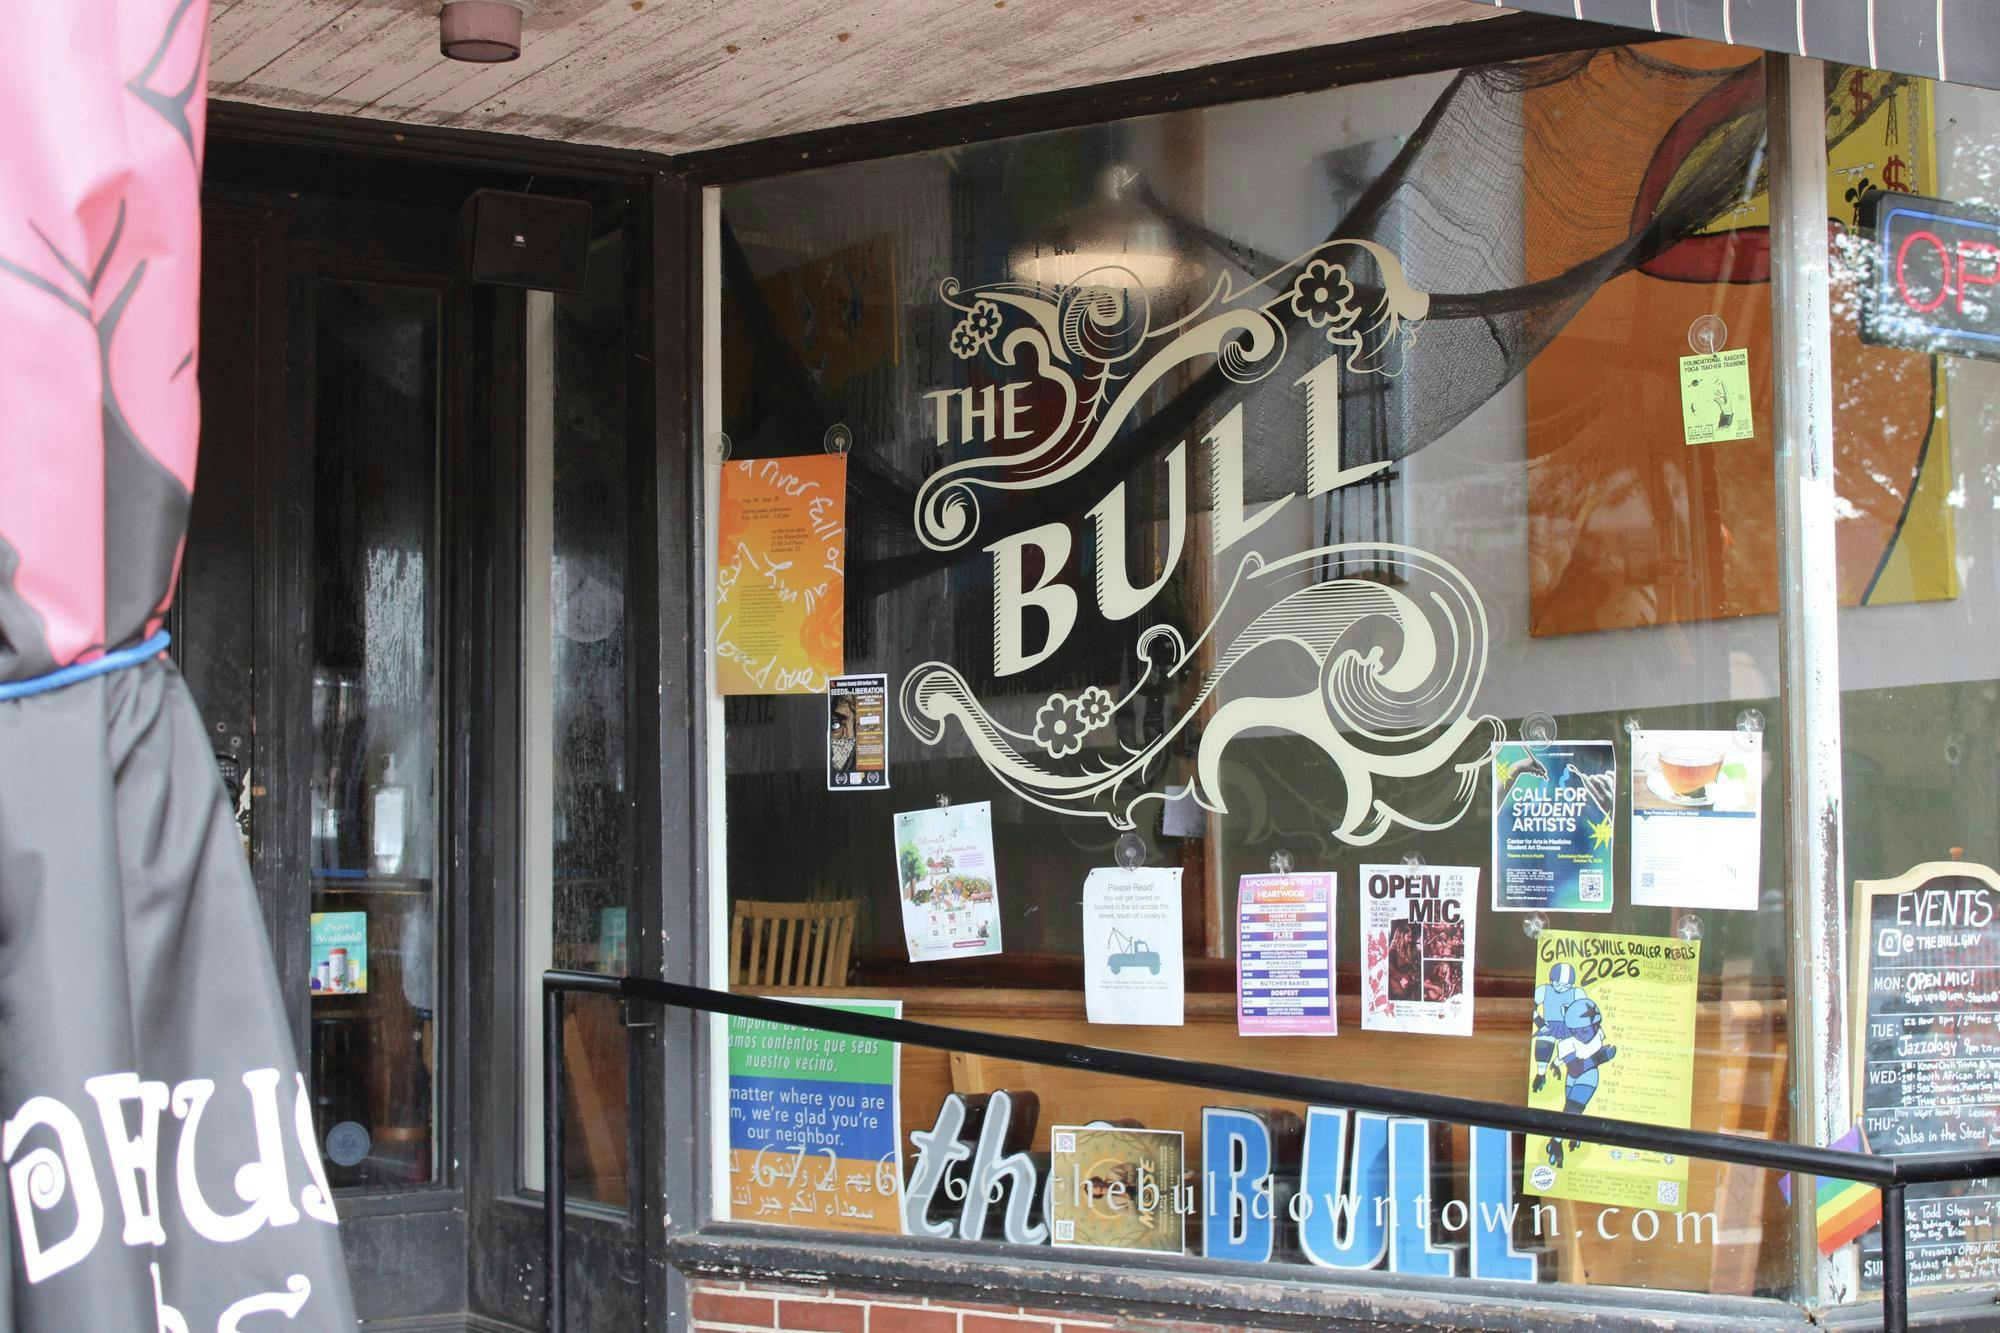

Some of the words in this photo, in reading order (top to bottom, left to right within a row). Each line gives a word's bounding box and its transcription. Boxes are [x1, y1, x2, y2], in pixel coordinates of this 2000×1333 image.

[922, 381, 1035, 446] THE
[761, 460, 820, 496] river
[809, 496, 843, 541] full
[982, 354, 1398, 677] BULL
[831, 688, 848, 696] SEEDS
[1511, 787, 1552, 802] CALL
[1554, 787, 1587, 802] FOR
[1511, 802, 1586, 817] STUDENT
[1511, 817, 1577, 832] ARTISTS
[1107, 883, 1132, 892] Please
[1246, 878, 1289, 887] UPCOMING
[1290, 877, 1322, 886] EVENTS
[1368, 874, 1441, 899] OPEN
[1257, 889, 1306, 898] HEARTWOOD
[1409, 899, 1461, 924] MIC
[1897, 889, 1992, 927] EVENTS
[1541, 938, 1626, 963] GAINESVILLE
[1628, 942, 1661, 959] ROLLER
[1664, 947, 1696, 960] REBELS
[1580, 957, 1640, 987] 2026
[1642, 960, 1668, 971] ROLLER
[1669, 963, 1692, 973] DERBY
[1643, 972, 1664, 981] HOME
[1665, 974, 1693, 983] SEASON
[1873, 977, 1905, 991] MON:
[1907, 972, 1941, 991] OPEN
[1944, 972, 1975, 987] MIC!
[1871, 1024, 1900, 1038] TUE:
[762, 1034, 820, 1052] contentos
[823, 1039, 846, 1056] que
[851, 1041, 879, 1055] seas
[1898, 1032, 1957, 1057] Jazzology
[746, 1054, 791, 1070] nuestro
[795, 1053, 839, 1073] vecino.
[1917, 1070, 1940, 1082] South
[1943, 1070, 1973, 1081] African
[1975, 1070, 1990, 1080] Trio
[729, 1086, 775, 1103] matter
[780, 1086, 823, 1106] where
[828, 1095, 855, 1111] you
[861, 1096, 886, 1110] are
[751, 1105, 790, 1122] we're
[794, 1107, 827, 1128] glad
[832, 1112, 879, 1131] you're
[1867, 1117, 1895, 1132] THU:
[747, 1126, 771, 1139] our
[776, 1126, 845, 1147] neighbor.
[1895, 1124, 1925, 1145] Salsa
[1928, 1130, 1937, 1142] in
[1940, 1122, 1956, 1141] the
[1960, 1122, 1985, 1140] Street
[1201, 1105, 1539, 1285] BULL
[1920, 1201, 1941, 1219] Todd
[1946, 1203, 1970, 1216] Show
[1920, 1247, 1956, 1258] Presents:
[1958, 1244, 1981, 1255] OPEN
